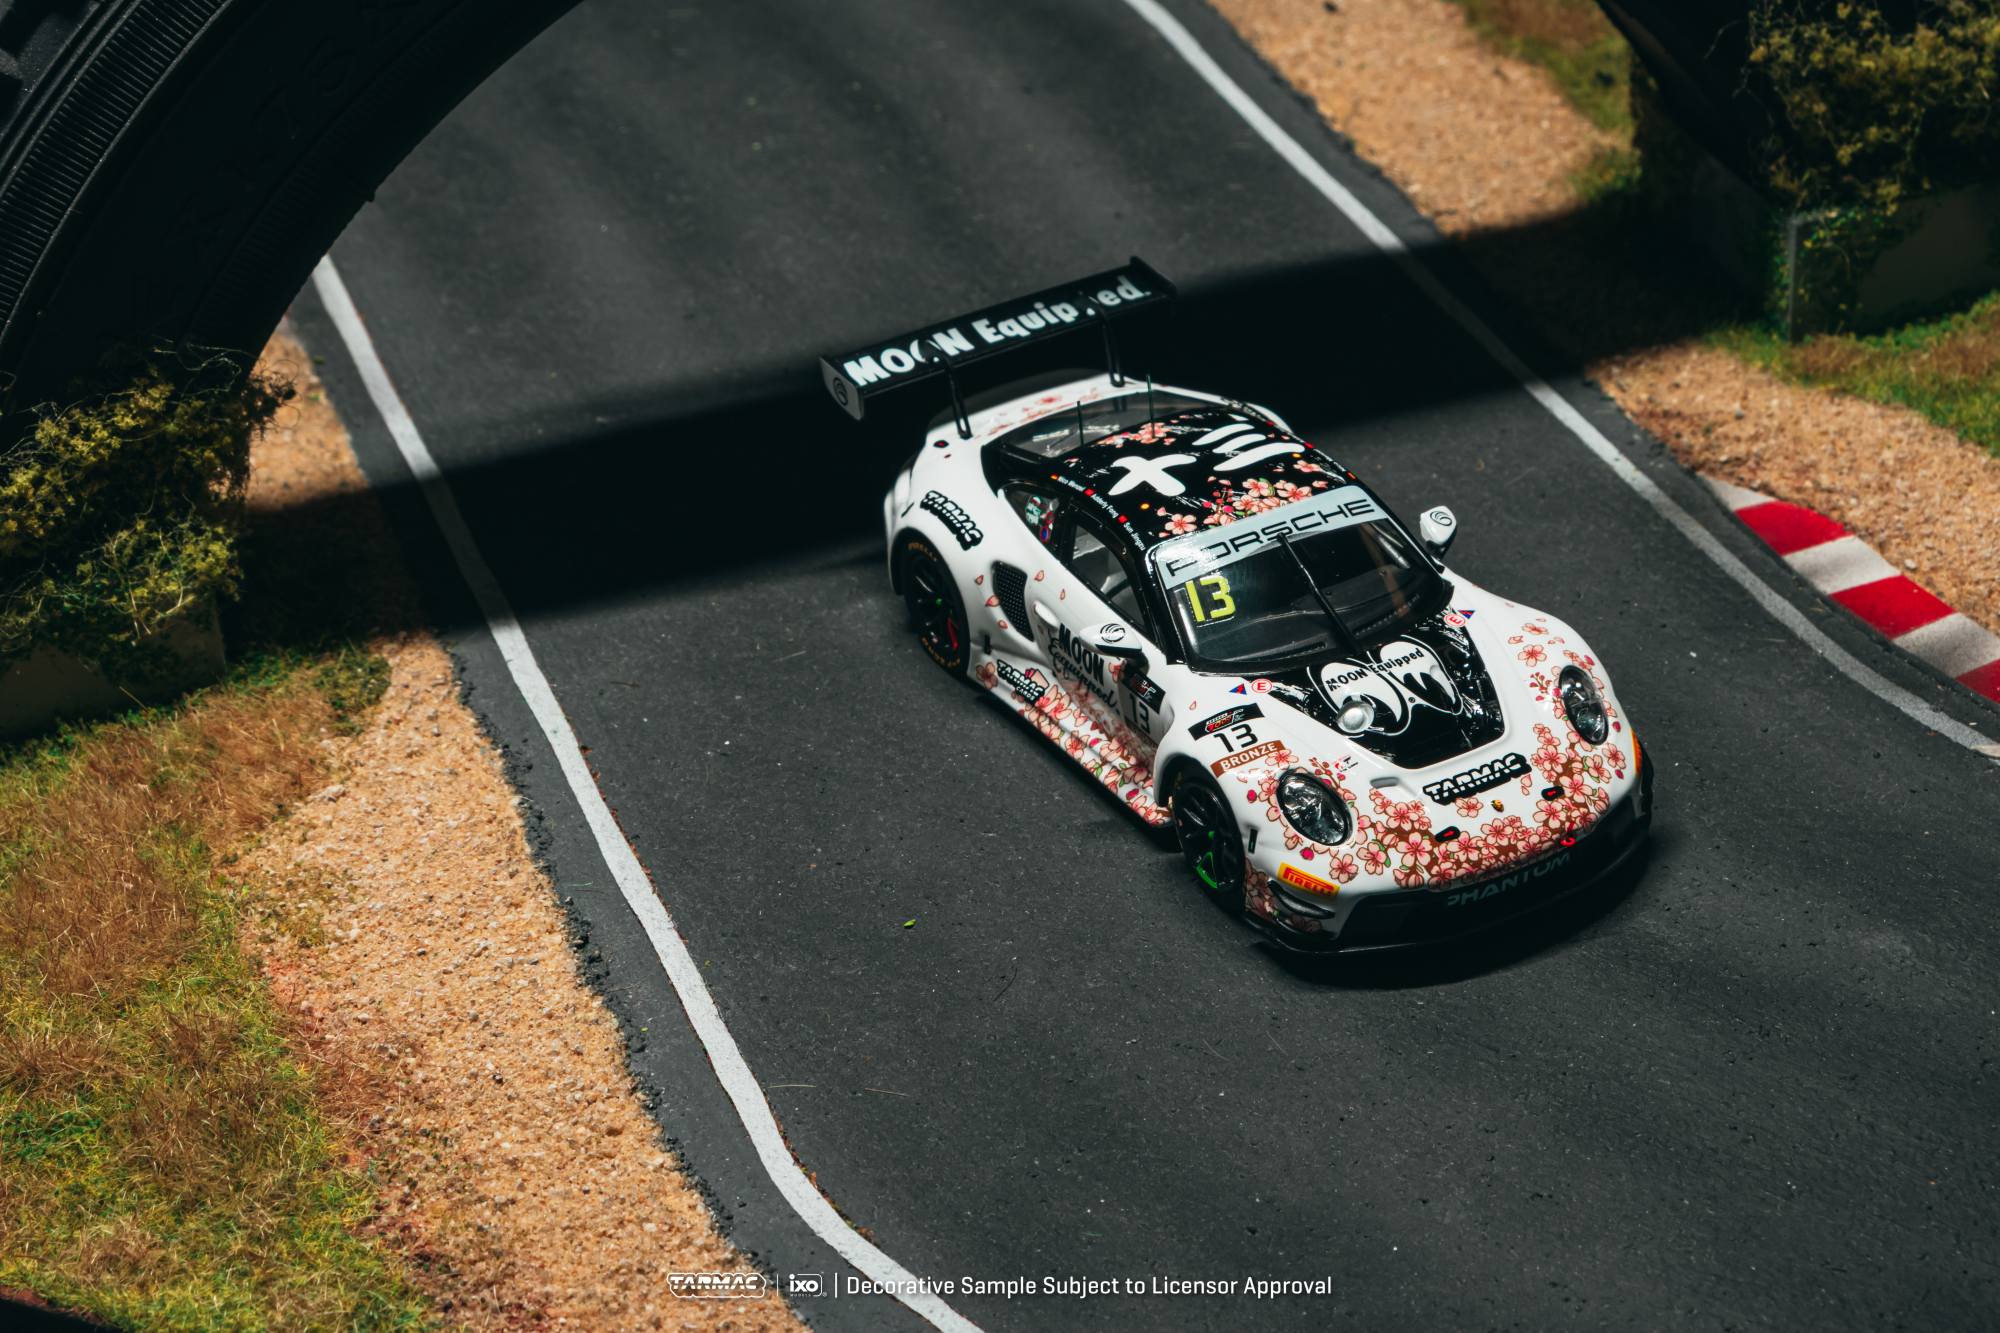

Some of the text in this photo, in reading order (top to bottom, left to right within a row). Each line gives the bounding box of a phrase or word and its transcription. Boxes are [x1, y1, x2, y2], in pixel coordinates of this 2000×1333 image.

[921, 491, 982, 546] TARMAC
[1185, 574, 1236, 623] 13
[1059, 623, 1104, 686] MOON
[1325, 647, 1425, 692] MOON Equipped
[998, 661, 1045, 698] TARMAC
[1016, 686, 1036, 701] CARDS
[1130, 693, 1150, 734] 13
[1213, 723, 1258, 753] 13
[1220, 742, 1278, 771] BRONZE
[1425, 754, 1525, 802] TARMAC
